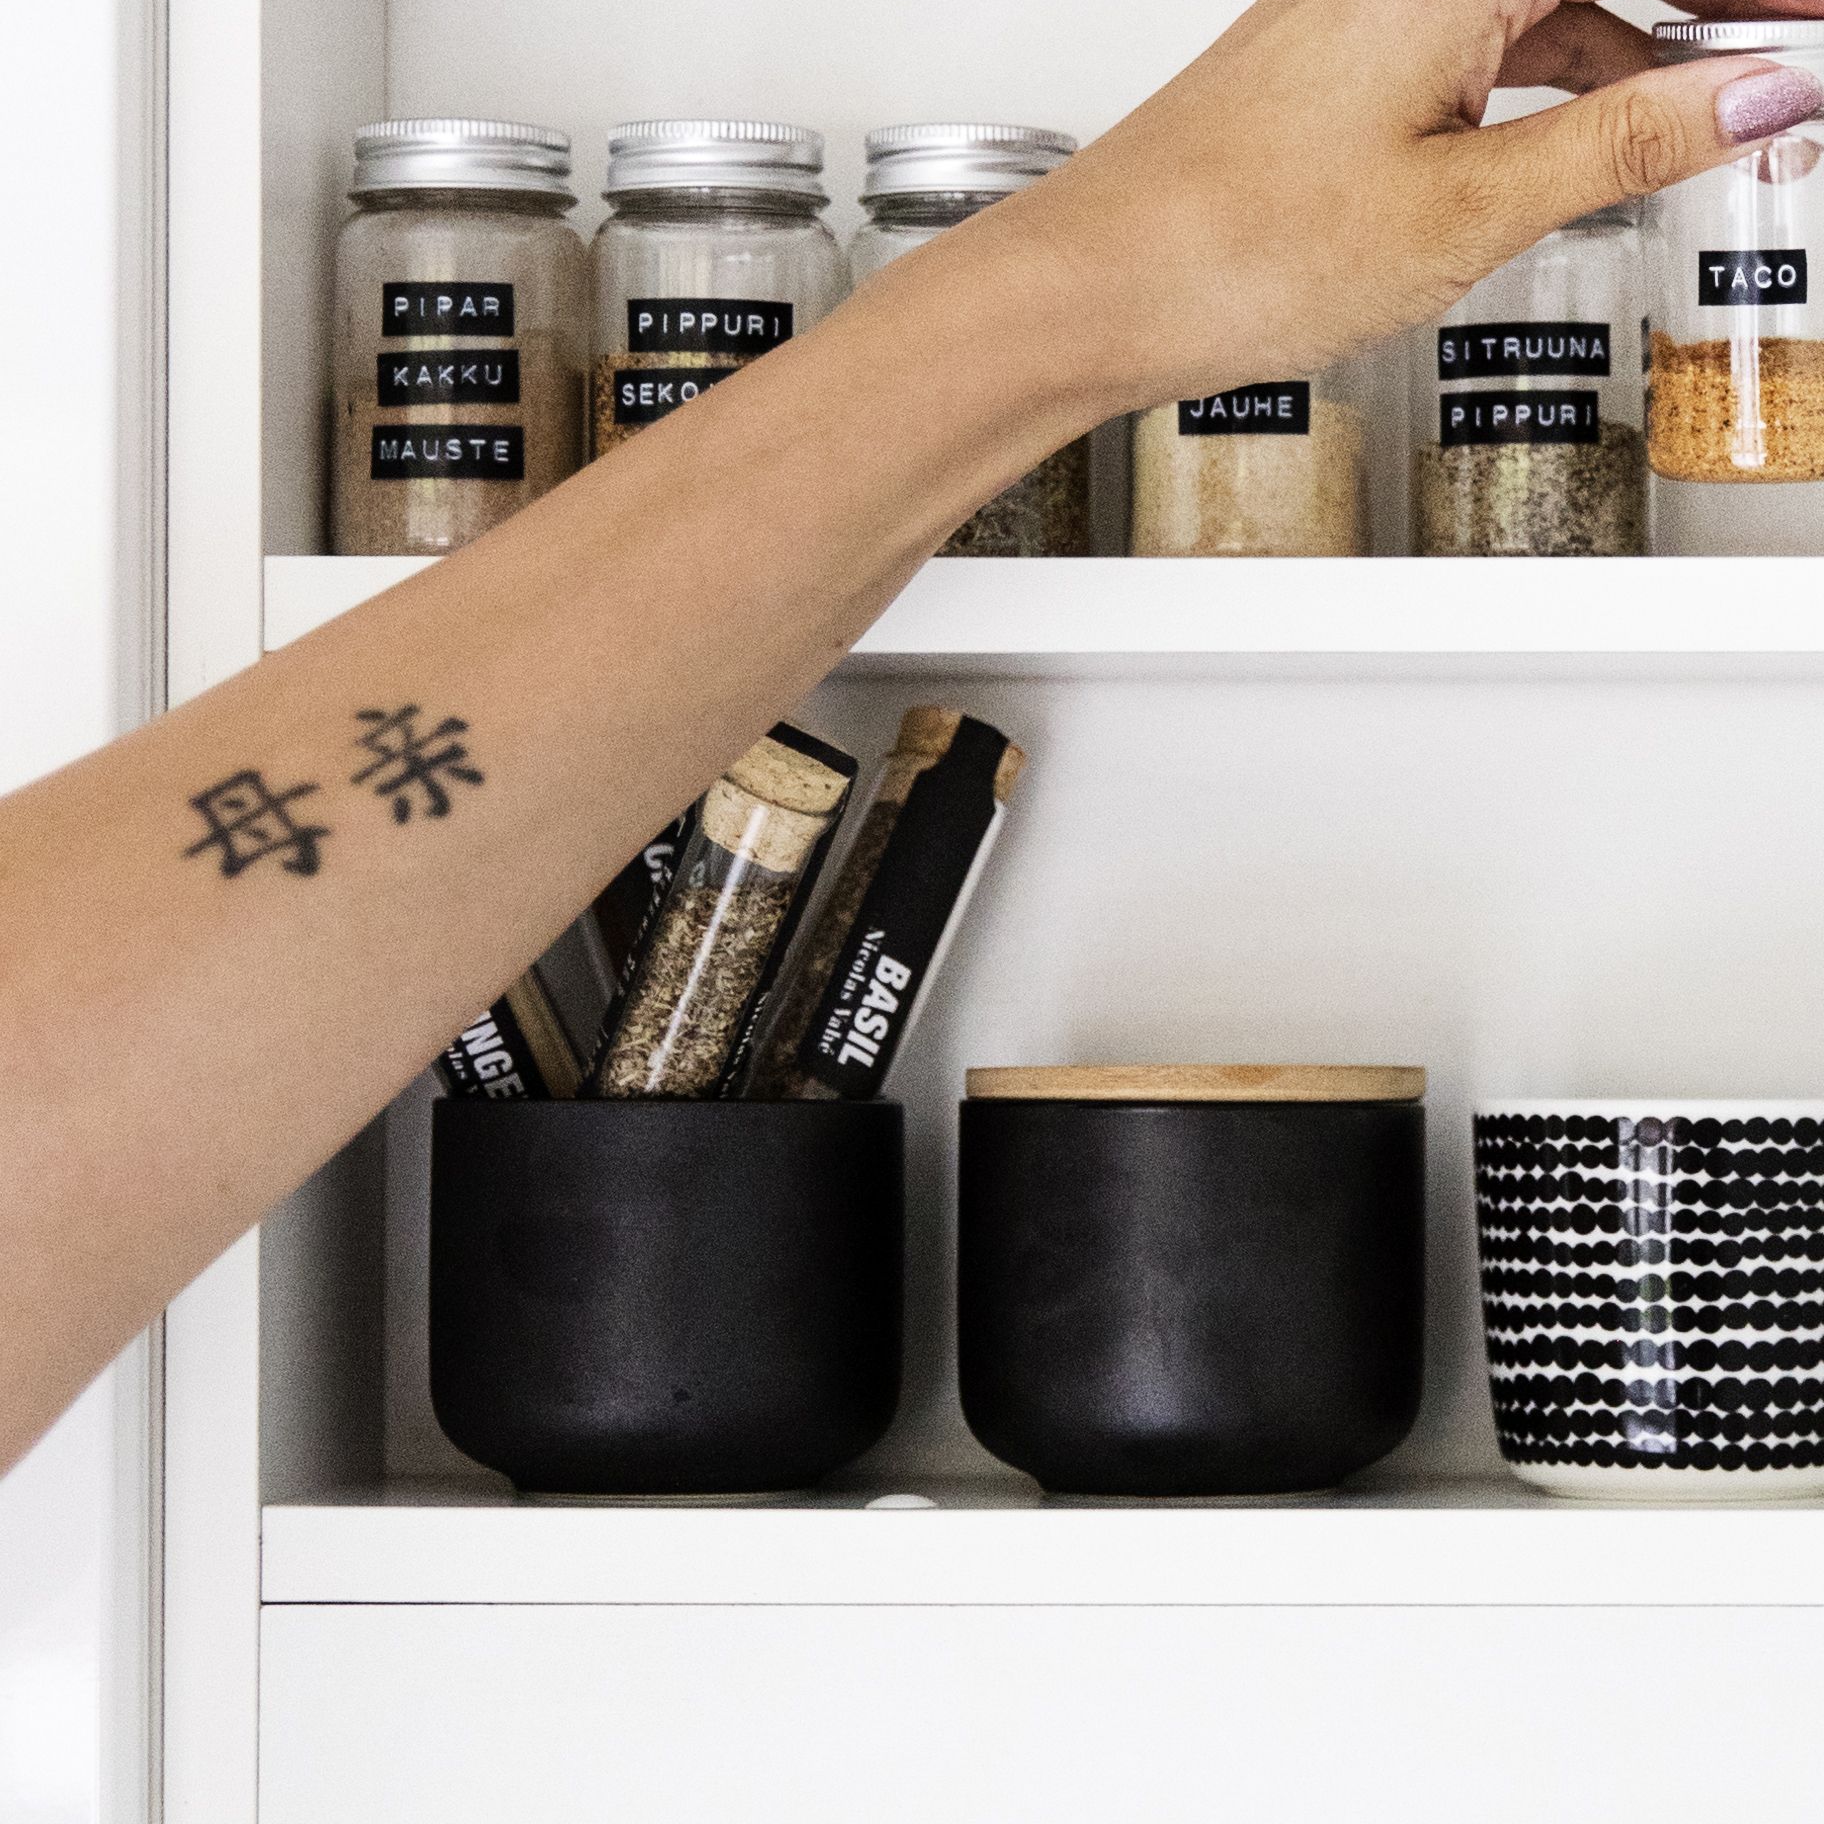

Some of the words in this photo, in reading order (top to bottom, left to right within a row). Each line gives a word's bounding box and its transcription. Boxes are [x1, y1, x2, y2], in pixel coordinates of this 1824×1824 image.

[1709, 264, 1797, 289] TACO
[394, 296, 501, 318] PIPAR
[638, 313, 780, 338] PIPPURI
[1440, 337, 1606, 362] SITRUUNA
[393, 364, 502, 387] KAKKU
[622, 381, 715, 406] SEKO
[1190, 395, 1293, 418] JAUHE
[1450, 405, 1593, 428] PIPPURI
[379, 438, 510, 462] MAUSTE
[182, 703, 486, 877] 母亲
[838, 929, 887, 1003] Nicolas
[837, 952, 913, 1069] BASIL
[461, 1010, 529, 1099] NGE
